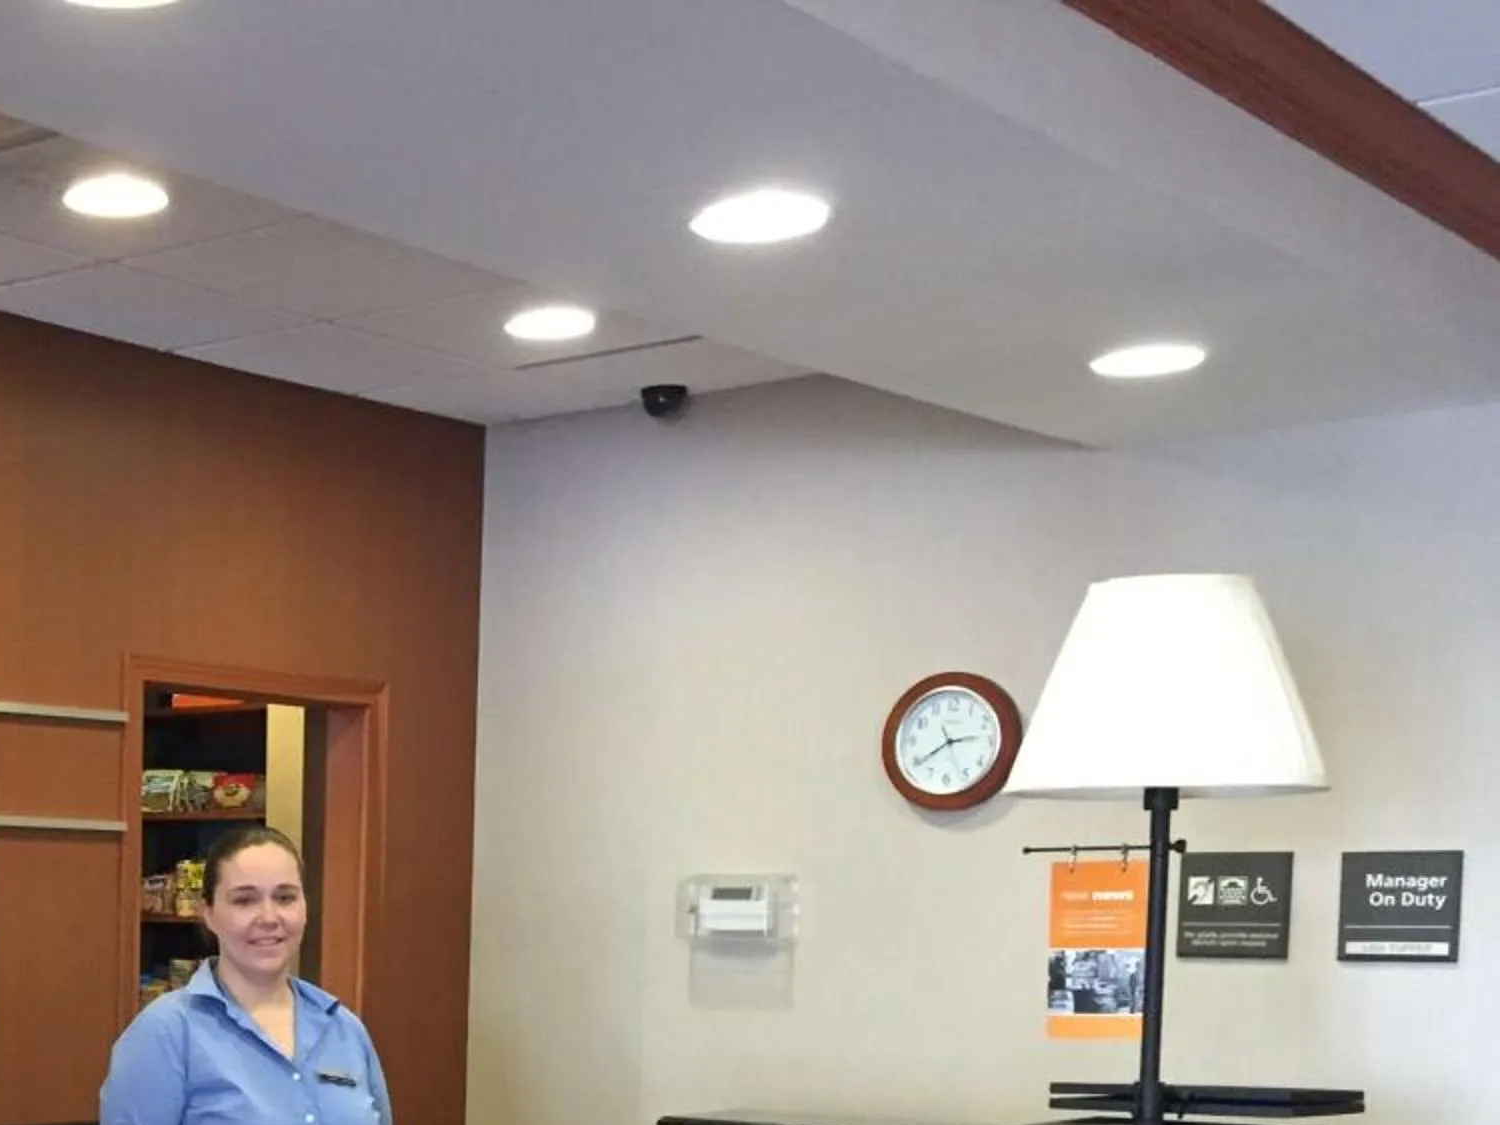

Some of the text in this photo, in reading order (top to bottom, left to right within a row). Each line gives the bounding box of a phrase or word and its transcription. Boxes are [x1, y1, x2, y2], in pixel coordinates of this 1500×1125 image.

[1365, 873, 1448, 891] Manager
[1369, 891, 1447, 911] On Duty
